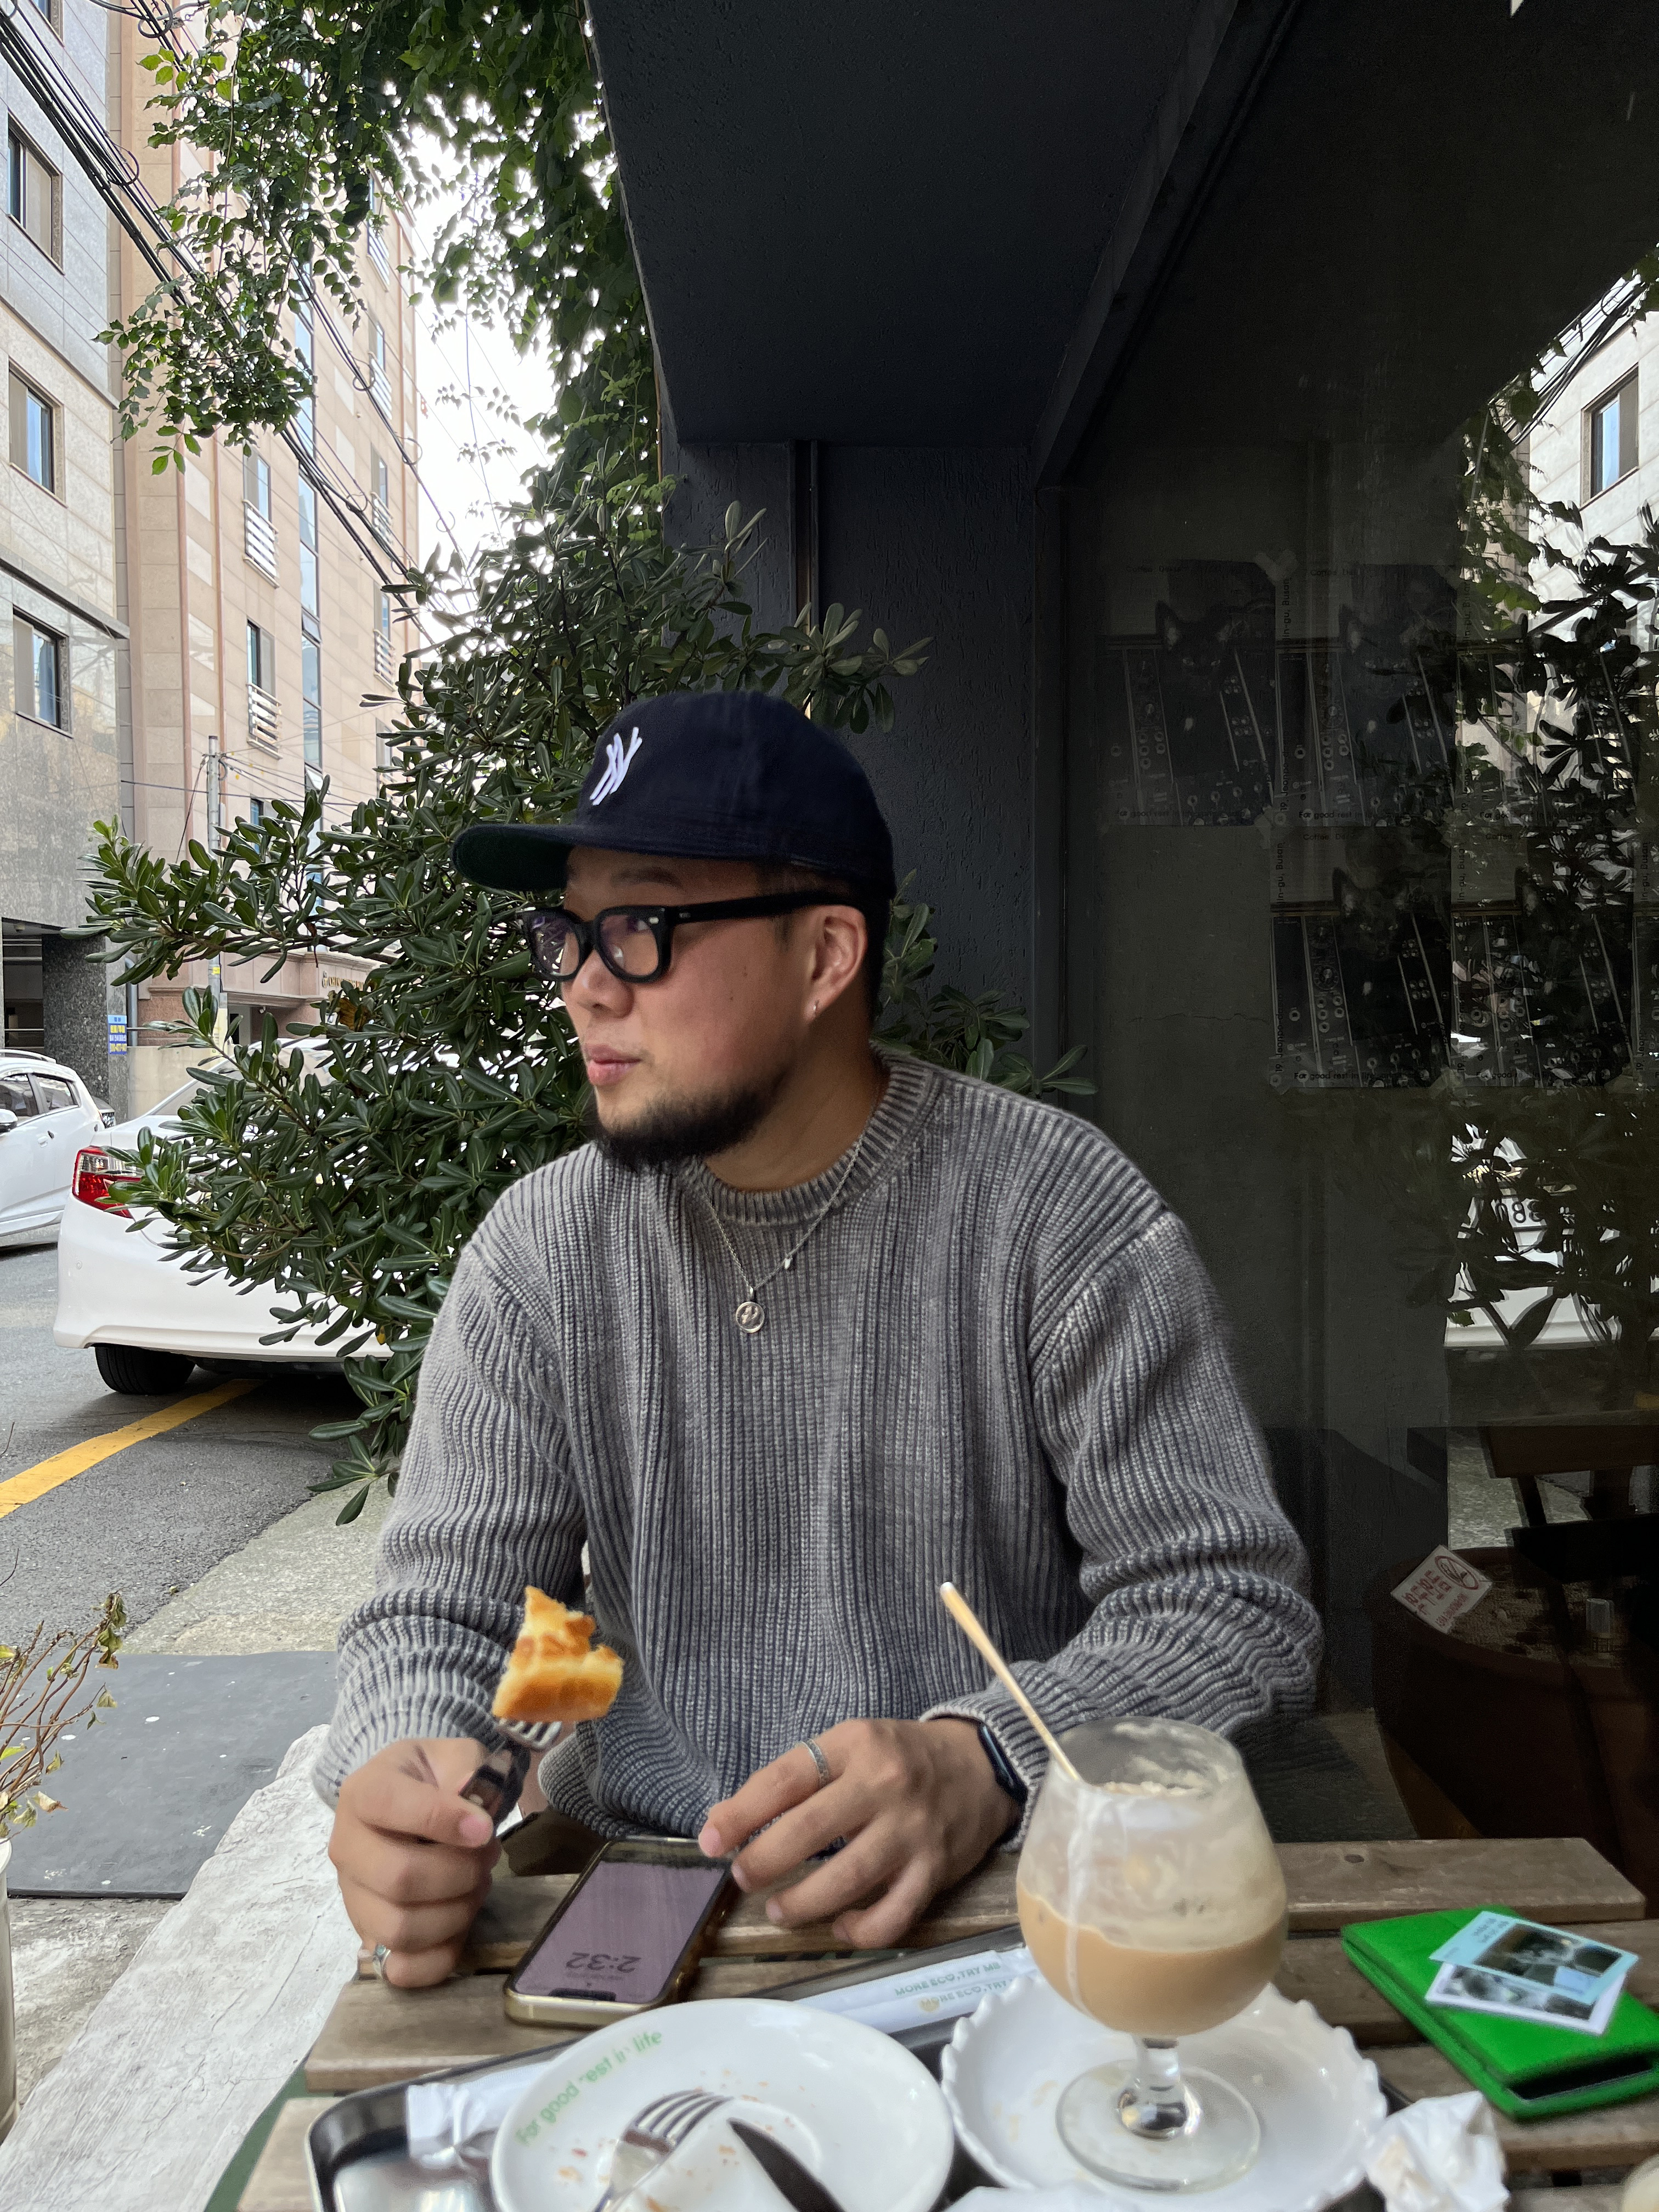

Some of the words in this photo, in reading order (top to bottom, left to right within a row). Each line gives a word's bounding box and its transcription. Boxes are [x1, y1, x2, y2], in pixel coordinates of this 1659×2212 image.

[1310, 1072, 1330, 1081] good
[566, 1951, 642, 1974] 2:32
[515, 2119, 541, 2146] For
[540, 2080, 579, 2124] good
[633, 2031, 662, 2052] life
